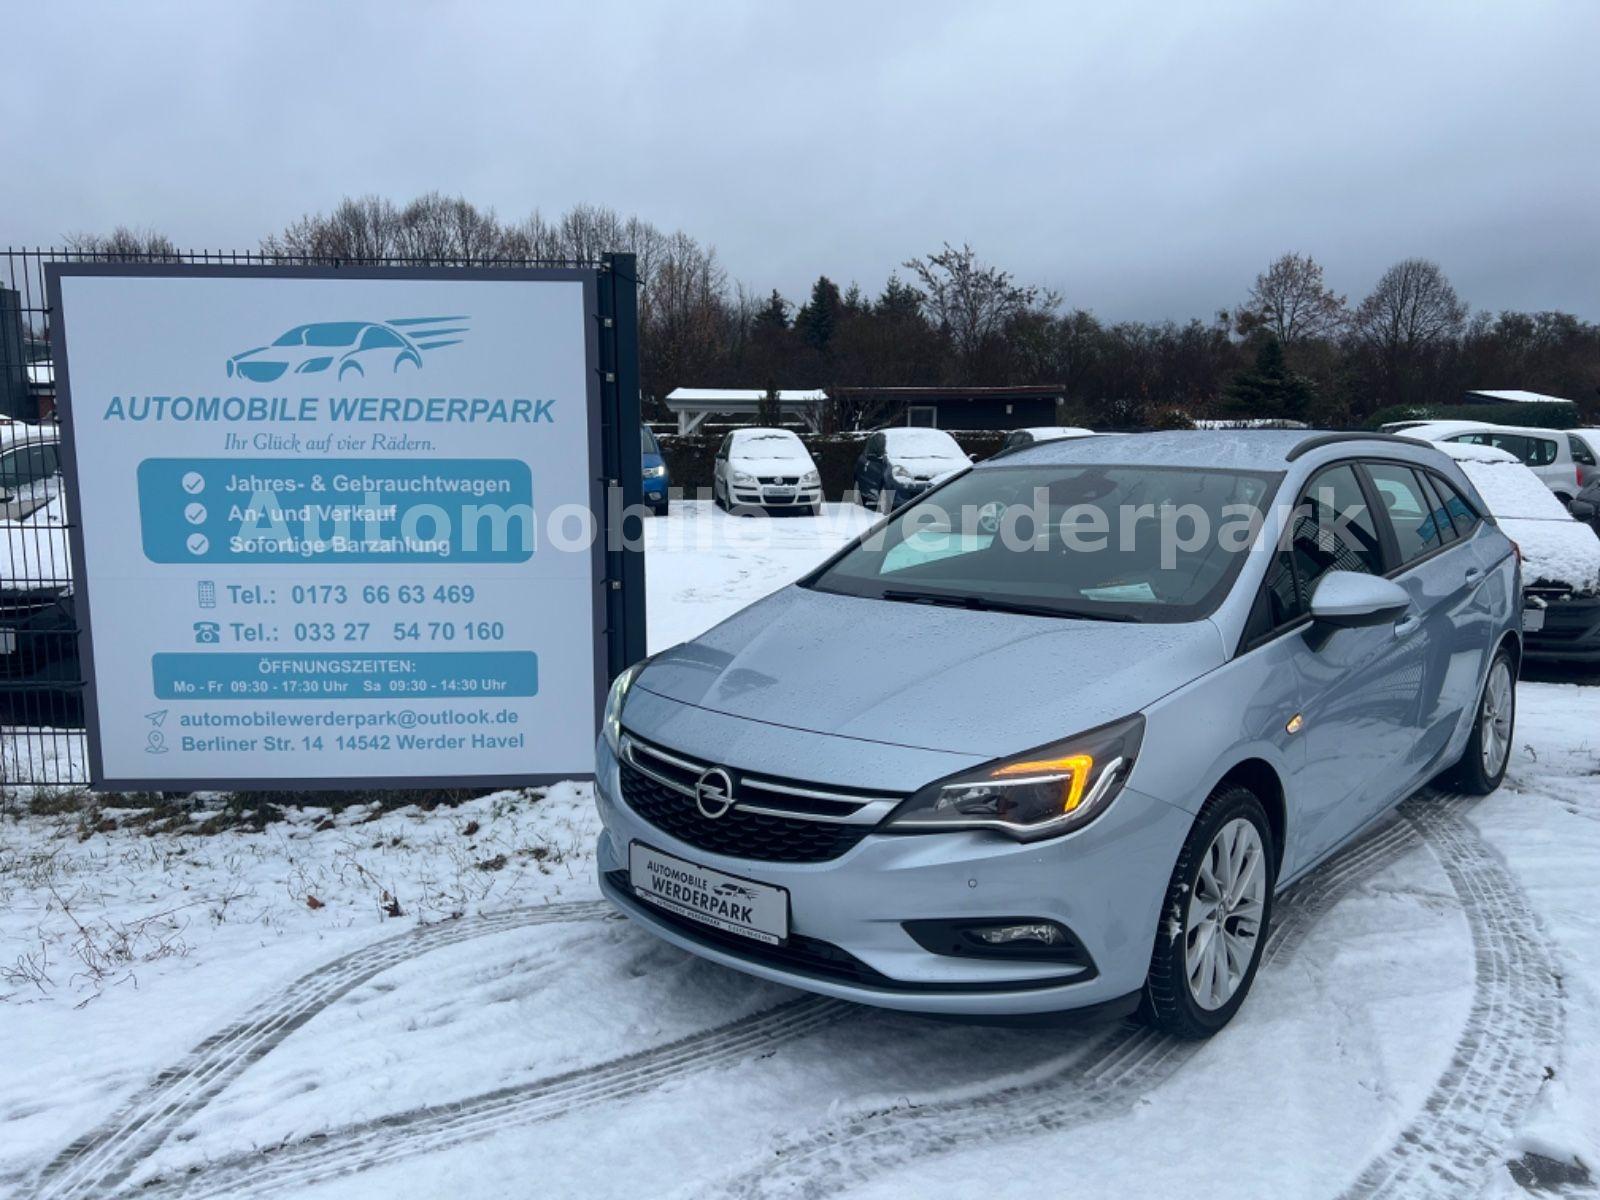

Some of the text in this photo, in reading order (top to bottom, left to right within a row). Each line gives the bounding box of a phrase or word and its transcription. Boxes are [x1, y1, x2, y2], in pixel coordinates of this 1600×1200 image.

[103, 396, 556, 423] AUTOMOBILE WERDERPARK
[224, 433, 437, 453] Ihr Glück auf vier Rädern.
[225, 474, 511, 496] Jahres- & Gebrauchtwagen
[228, 504, 398, 522] An- und Verkauf
[229, 536, 450, 557] Sofortige Barzahlung
[226, 585, 476, 604] Tel.: 0173 66 63 469
[229, 622, 505, 642] Tel.: 033 27 54 70 160
[258, 658, 417, 674] ÖFFNUNGSZEITEN:
[173, 681, 196, 693] Mo
[208, 680, 224, 693] Fr
[230, 680, 269, 693] 09:30
[282, 680, 319, 693] 17:30
[323, 680, 348, 693] Uhr
[363, 680, 382, 692] Sa
[389, 680, 428, 692] 09:30
[440, 679, 478, 692] 14:30
[481, 678, 508, 692] Uhr
[179, 709, 520, 729] automobilewerderpark@outlook.de
[181, 733, 524, 751] Berliner Str. 14 14542 Werder Havel
[647, 859, 708, 892] AUTOMOBILE
[651, 874, 754, 924] WERDERPARK
